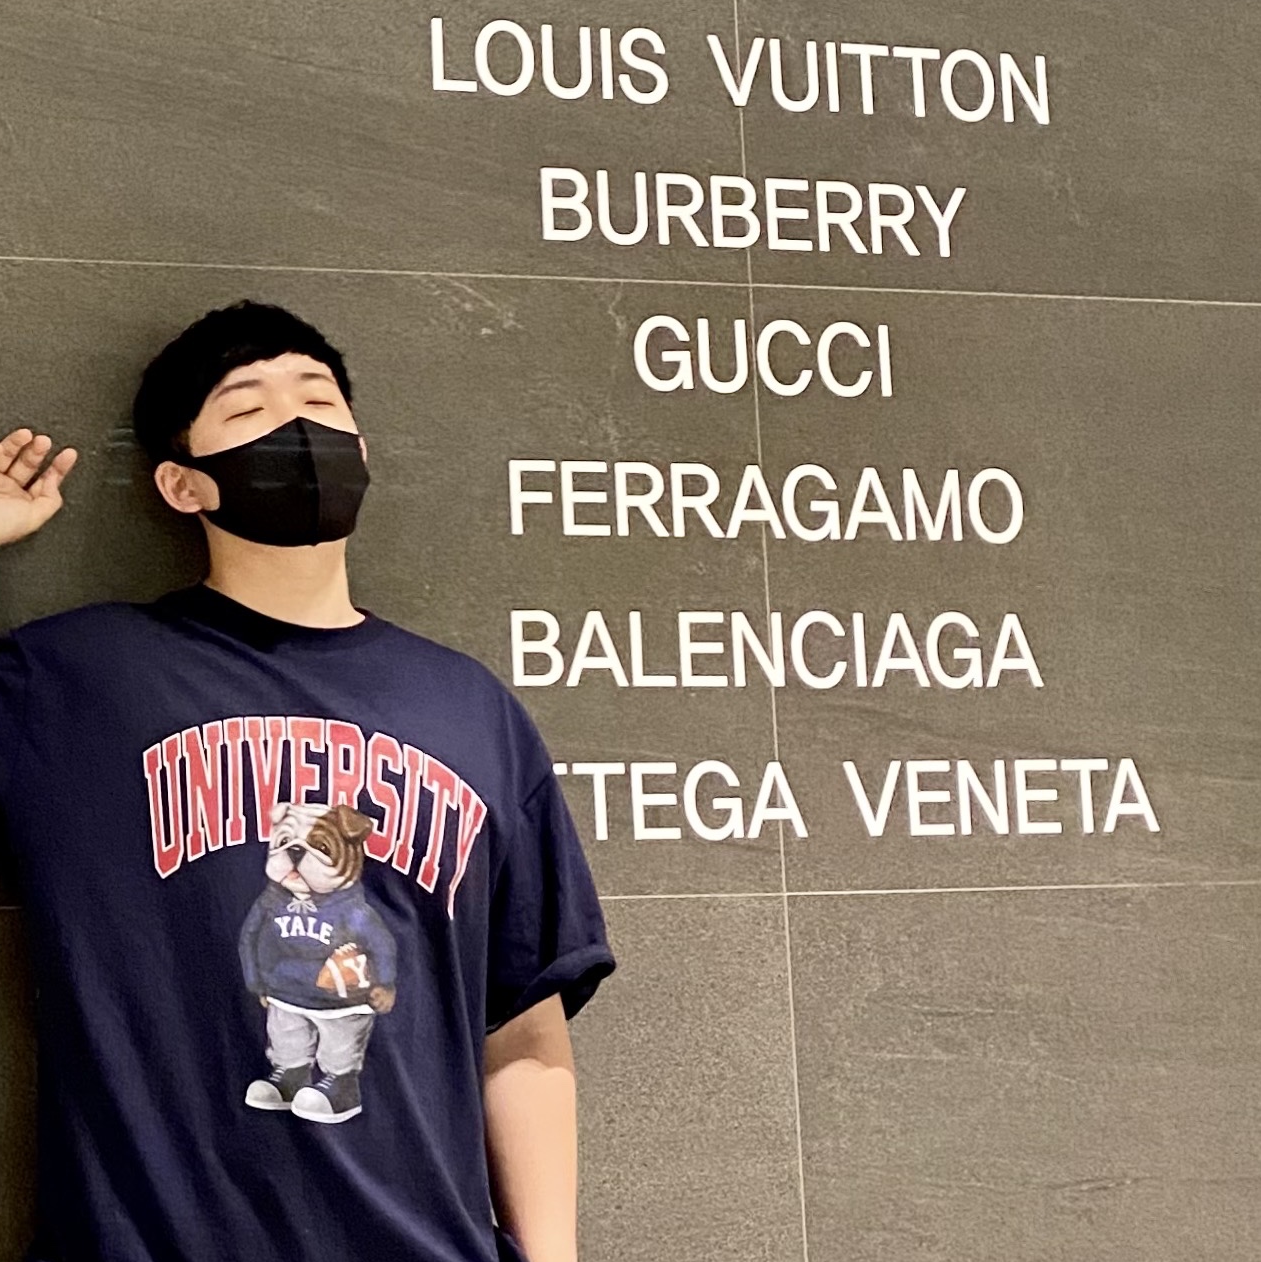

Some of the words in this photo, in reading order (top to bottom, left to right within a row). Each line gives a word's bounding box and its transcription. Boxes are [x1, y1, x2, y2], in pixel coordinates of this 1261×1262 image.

[430, 17, 669, 105] LOUIS
[706, 34, 1050, 125] VUITTON
[540, 167, 967, 258] BURBERRY
[633, 315, 893, 398] GUCCI
[508, 459, 1024, 545] FERRAGAMO
[510, 610, 1045, 689] BALENCIAGA
[143, 715, 488, 920] UNIVERSITY
[552, 760, 809, 841] TEGA
[842, 758, 1161, 838] VENETA
[274, 915, 334, 945] YALE
